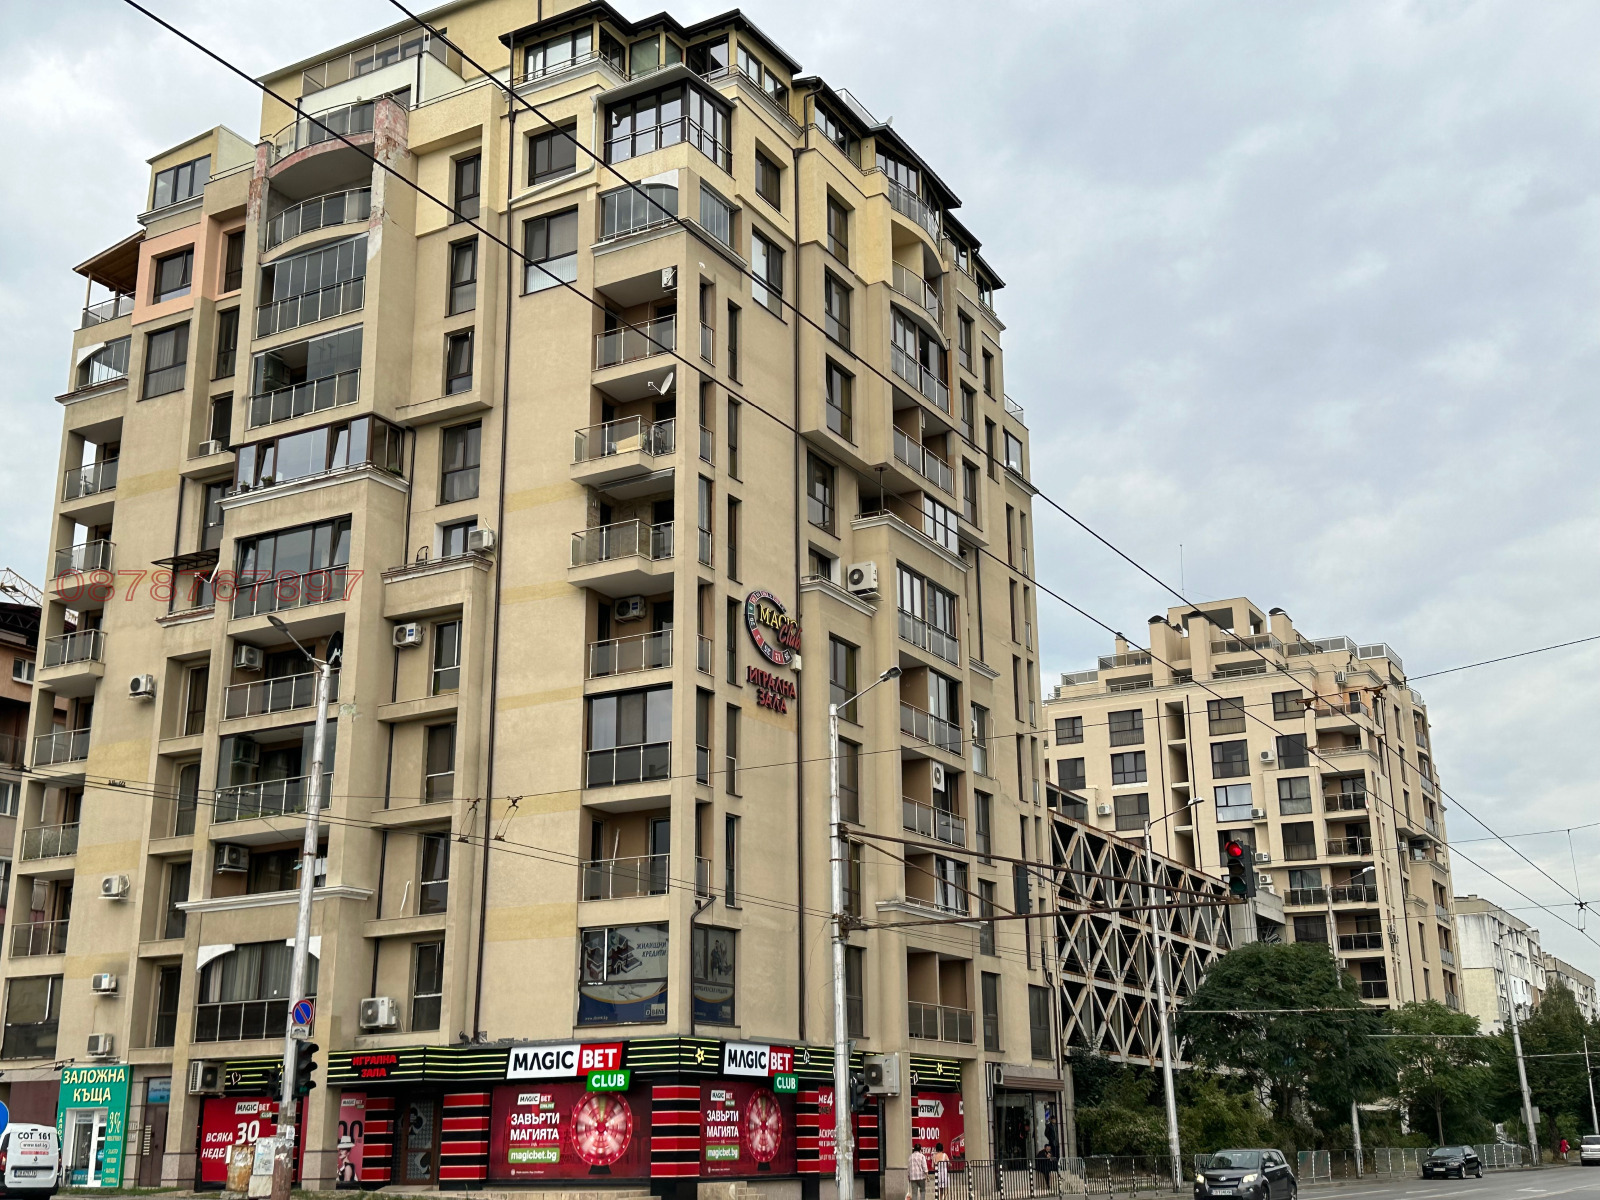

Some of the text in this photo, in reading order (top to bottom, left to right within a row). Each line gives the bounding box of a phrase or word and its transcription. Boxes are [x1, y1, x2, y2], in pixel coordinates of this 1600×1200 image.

[748, 666, 796, 700] ИГРАЛНА
[758, 689, 787, 714] ЗАЛА
[353, 1055, 397, 1066] ИГРАЛНА
[513, 1048, 617, 1071] MAGIC BET
[727, 1049, 791, 1071] MAGIC BET
[63, 1068, 125, 1084] ЗАЛОЖНА
[361, 1068, 387, 1078] ЗАЛА
[591, 1074, 625, 1088] CLUB
[776, 1077, 796, 1090] CLUB
[73, 1087, 111, 1104] КЪЩА
[511, 1112, 560, 1125] ЗАВЪРТИ
[706, 1110, 739, 1122] ЗАВЪРТИ
[39, 1132, 51, 1140] 161
[206, 1132, 233, 1142] ВСЯКА
[510, 1128, 559, 1141] МАГИЯТА
[706, 1126, 739, 1138] МАГИЯТА
[511, 1150, 557, 1161] magicbet.bg
[707, 1147, 739, 1159] magicbet.bg
